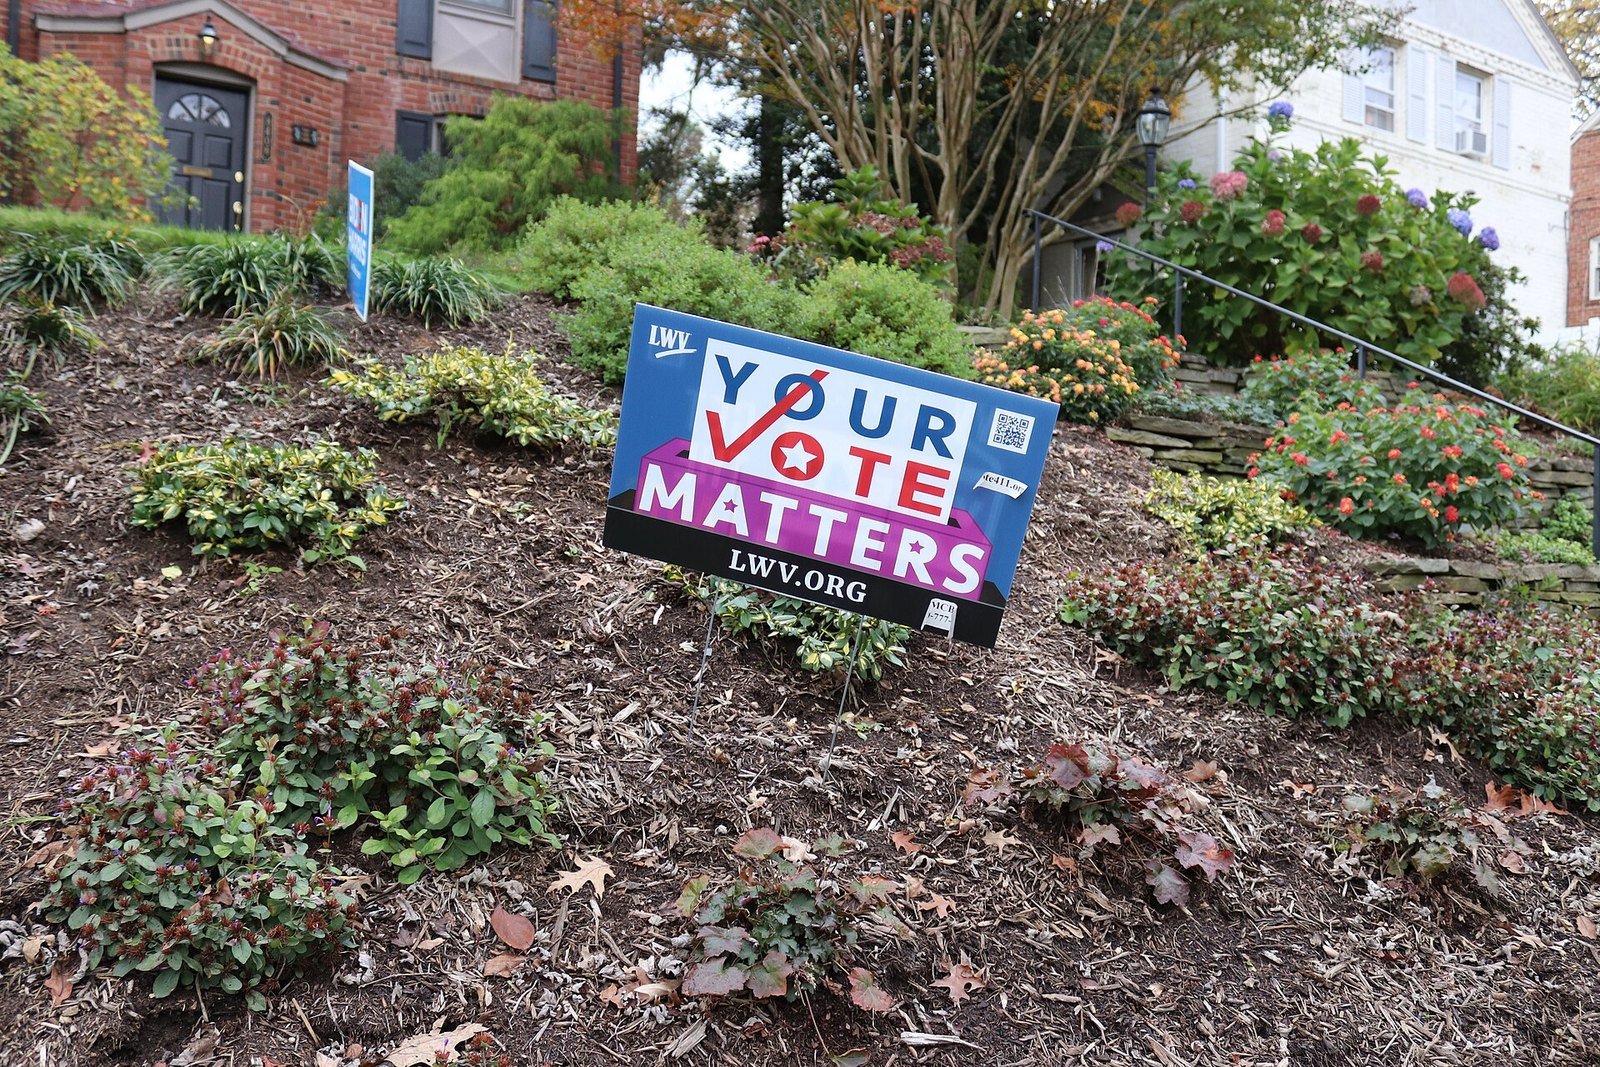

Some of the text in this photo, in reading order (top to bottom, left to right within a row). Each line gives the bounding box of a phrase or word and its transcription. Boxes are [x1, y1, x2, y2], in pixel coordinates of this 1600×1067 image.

[648, 324, 692, 350] LWV
[715, 354, 957, 459] YOUR
[705, 408, 951, 517] VOTE
[638, 464, 985, 595] MATTERS
[729, 549, 867, 603] LWV.ORG
